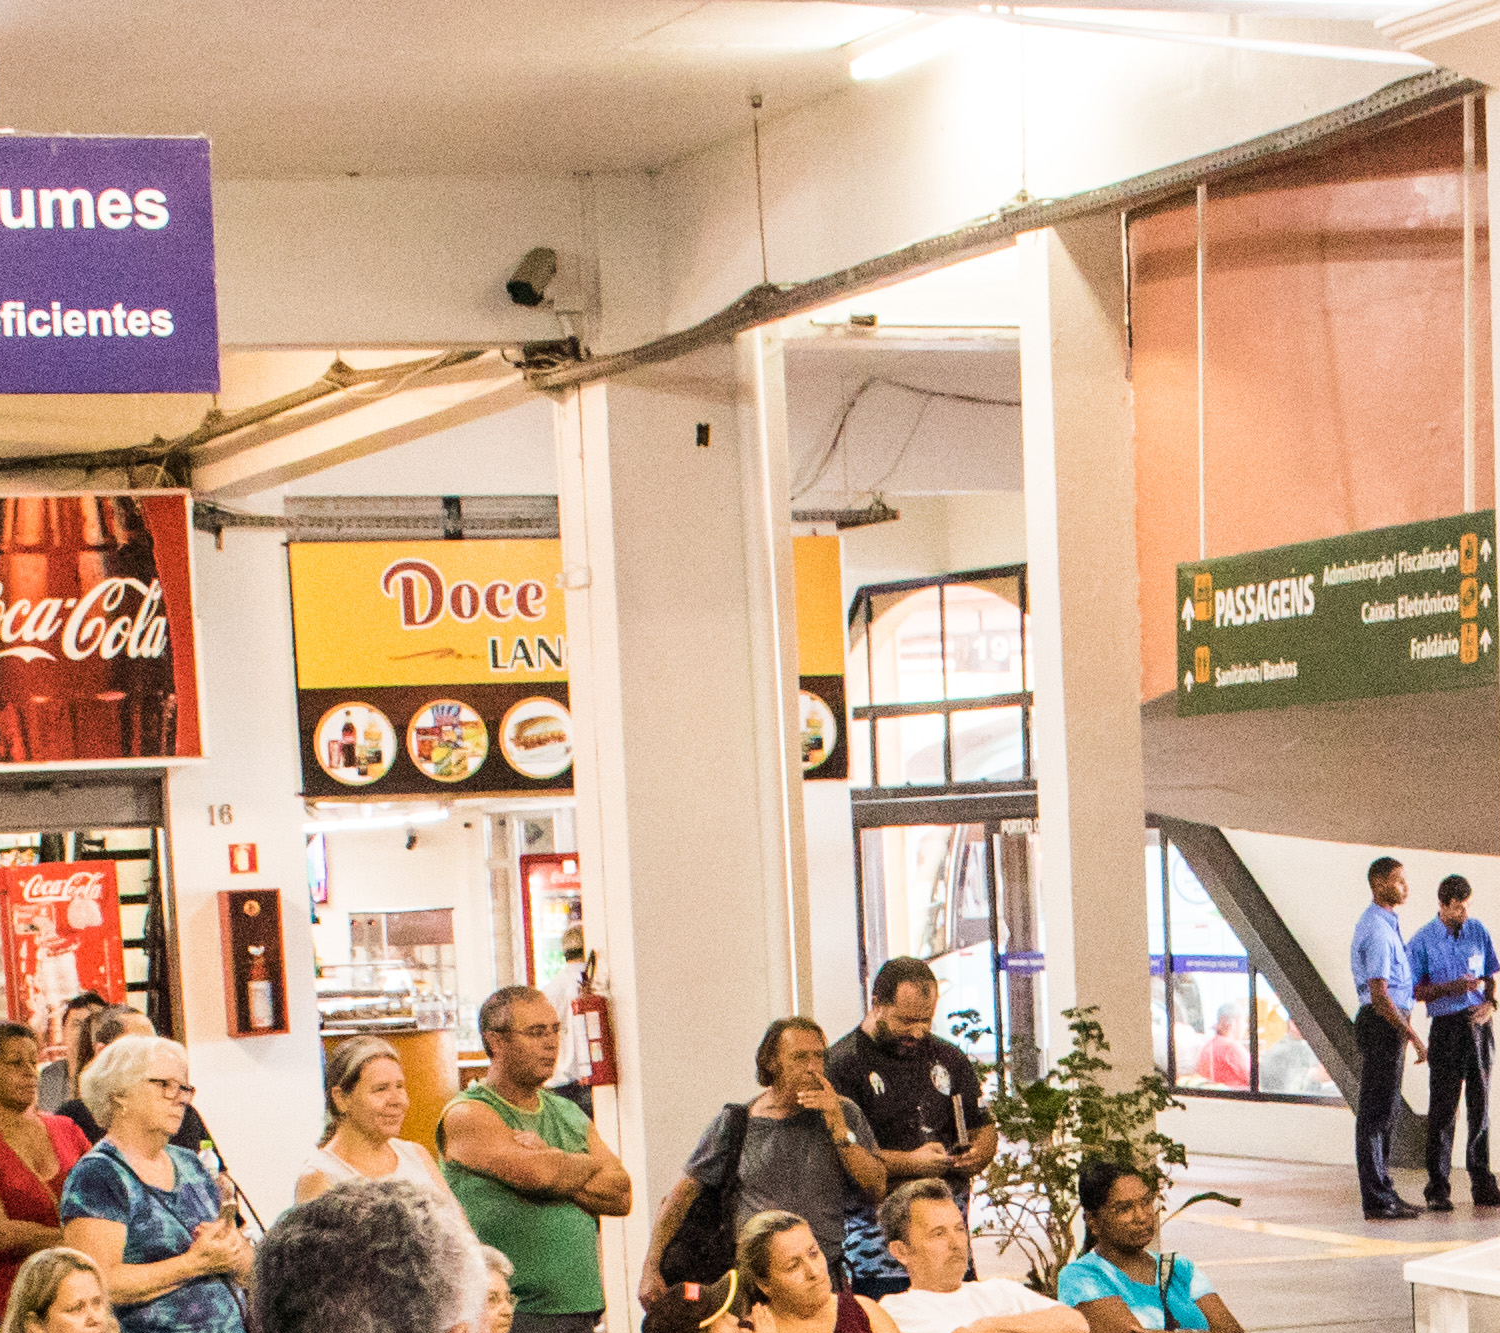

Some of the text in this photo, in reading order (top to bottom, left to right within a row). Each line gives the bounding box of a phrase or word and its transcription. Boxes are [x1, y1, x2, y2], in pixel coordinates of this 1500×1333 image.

[381, 559, 546, 630] Doce
[1214, 573, 1316, 629] PASSAGENS
[1361, 600, 1395, 624] Caixas
[207, 803, 234, 827] 16
